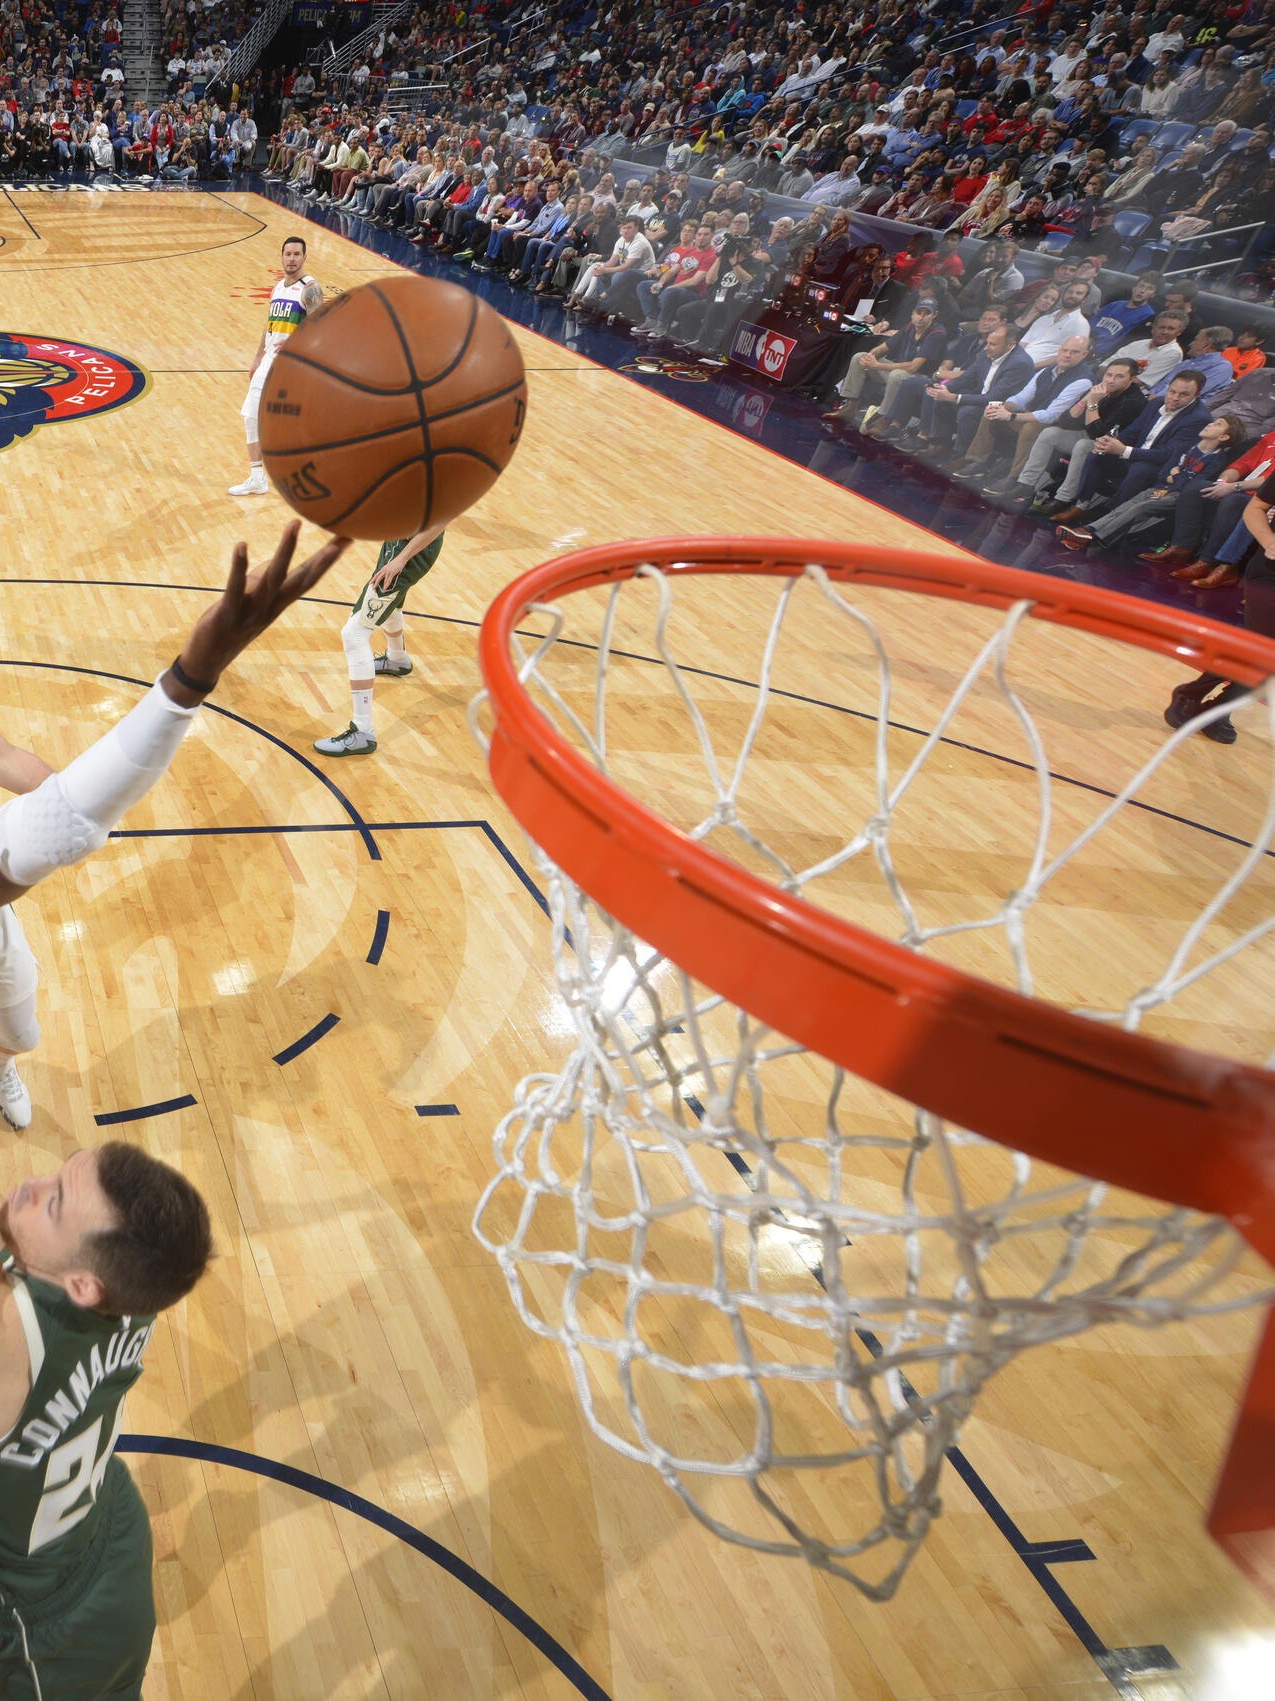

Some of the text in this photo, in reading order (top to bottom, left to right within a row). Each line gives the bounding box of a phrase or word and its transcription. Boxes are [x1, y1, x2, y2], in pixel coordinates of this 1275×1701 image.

[734, 330, 785, 367] NBA TNT
[36, 343, 116, 405] PELICANS
